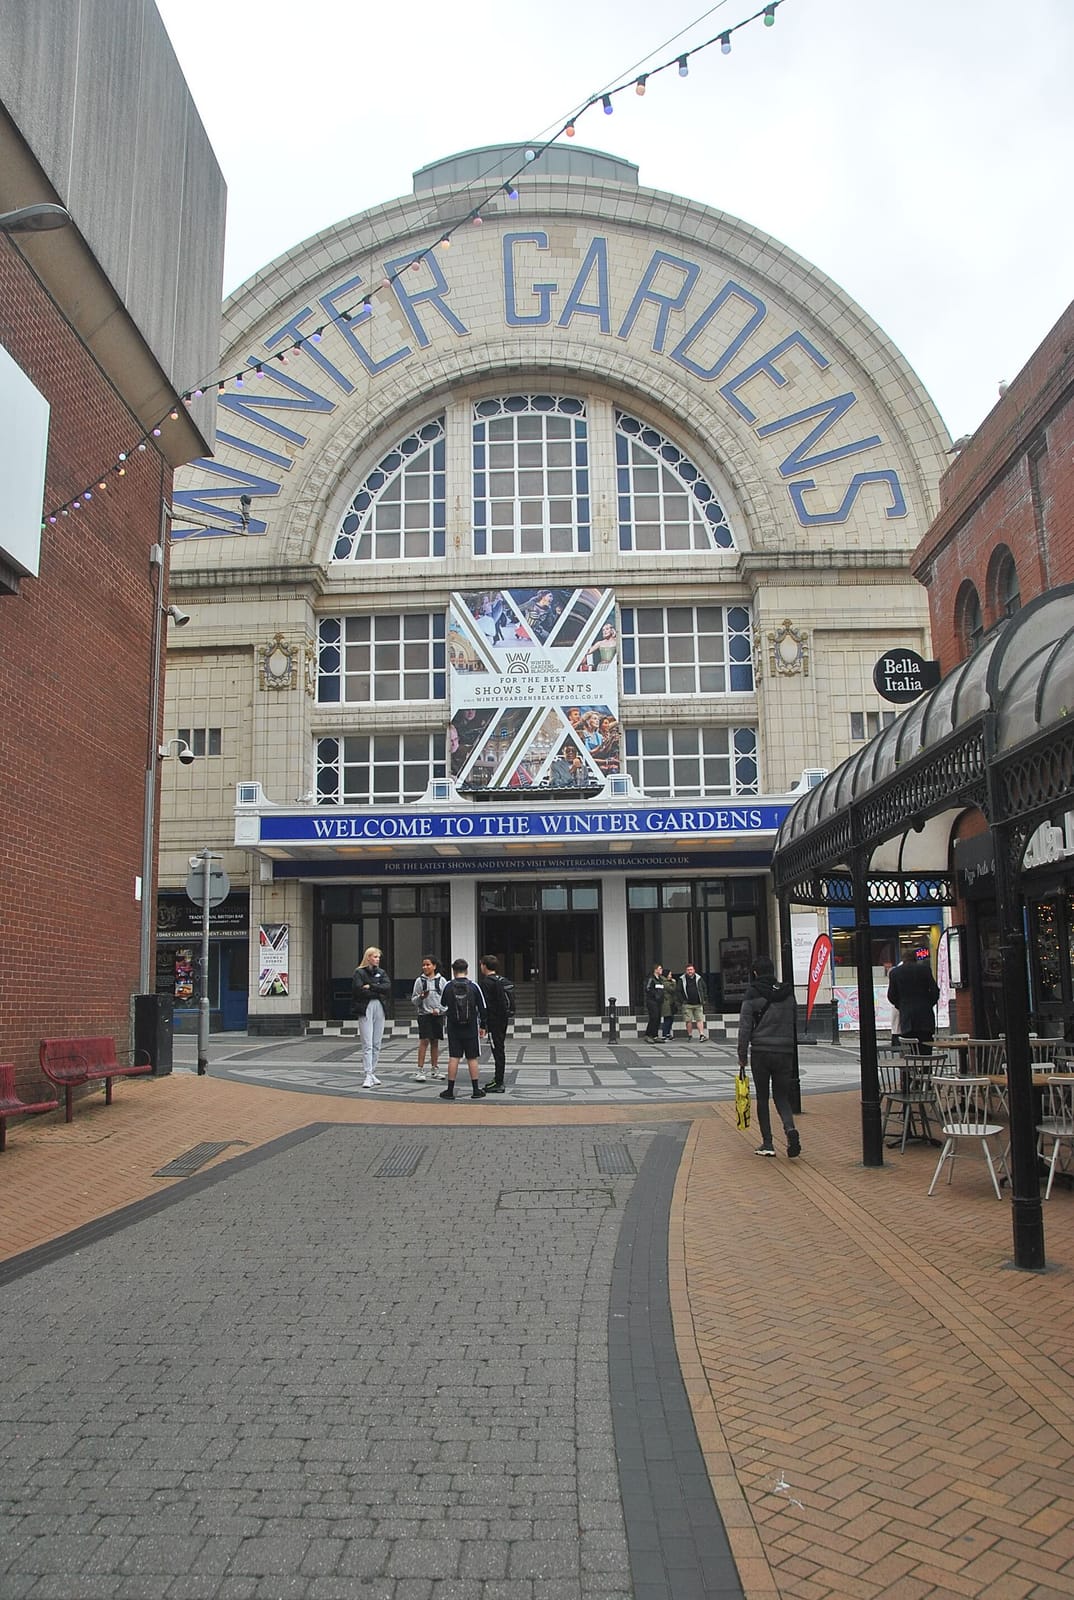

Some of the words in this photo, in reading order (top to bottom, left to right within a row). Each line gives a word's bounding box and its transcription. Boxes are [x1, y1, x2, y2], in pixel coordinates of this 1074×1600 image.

[172, 248, 471, 541] WINTER
[503, 231, 909, 528] GARDENS
[883, 659, 920, 673] Bella
[475, 686, 521, 695] SHOWS
[527, 686, 534, 694] &
[541, 684, 592, 694] EVENTS
[885, 677, 923, 691] Italia
[313, 818, 432, 838] WELCOME
[441, 817, 474, 836] TO
[480, 816, 530, 835] THE
[540, 813, 638, 834] WINTER
[646, 810, 762, 831] GARDENS
[447, 861, 476, 869] SHOWS
[497, 860, 525, 868] EVENTS
[526, 859, 546, 867] VISIT
